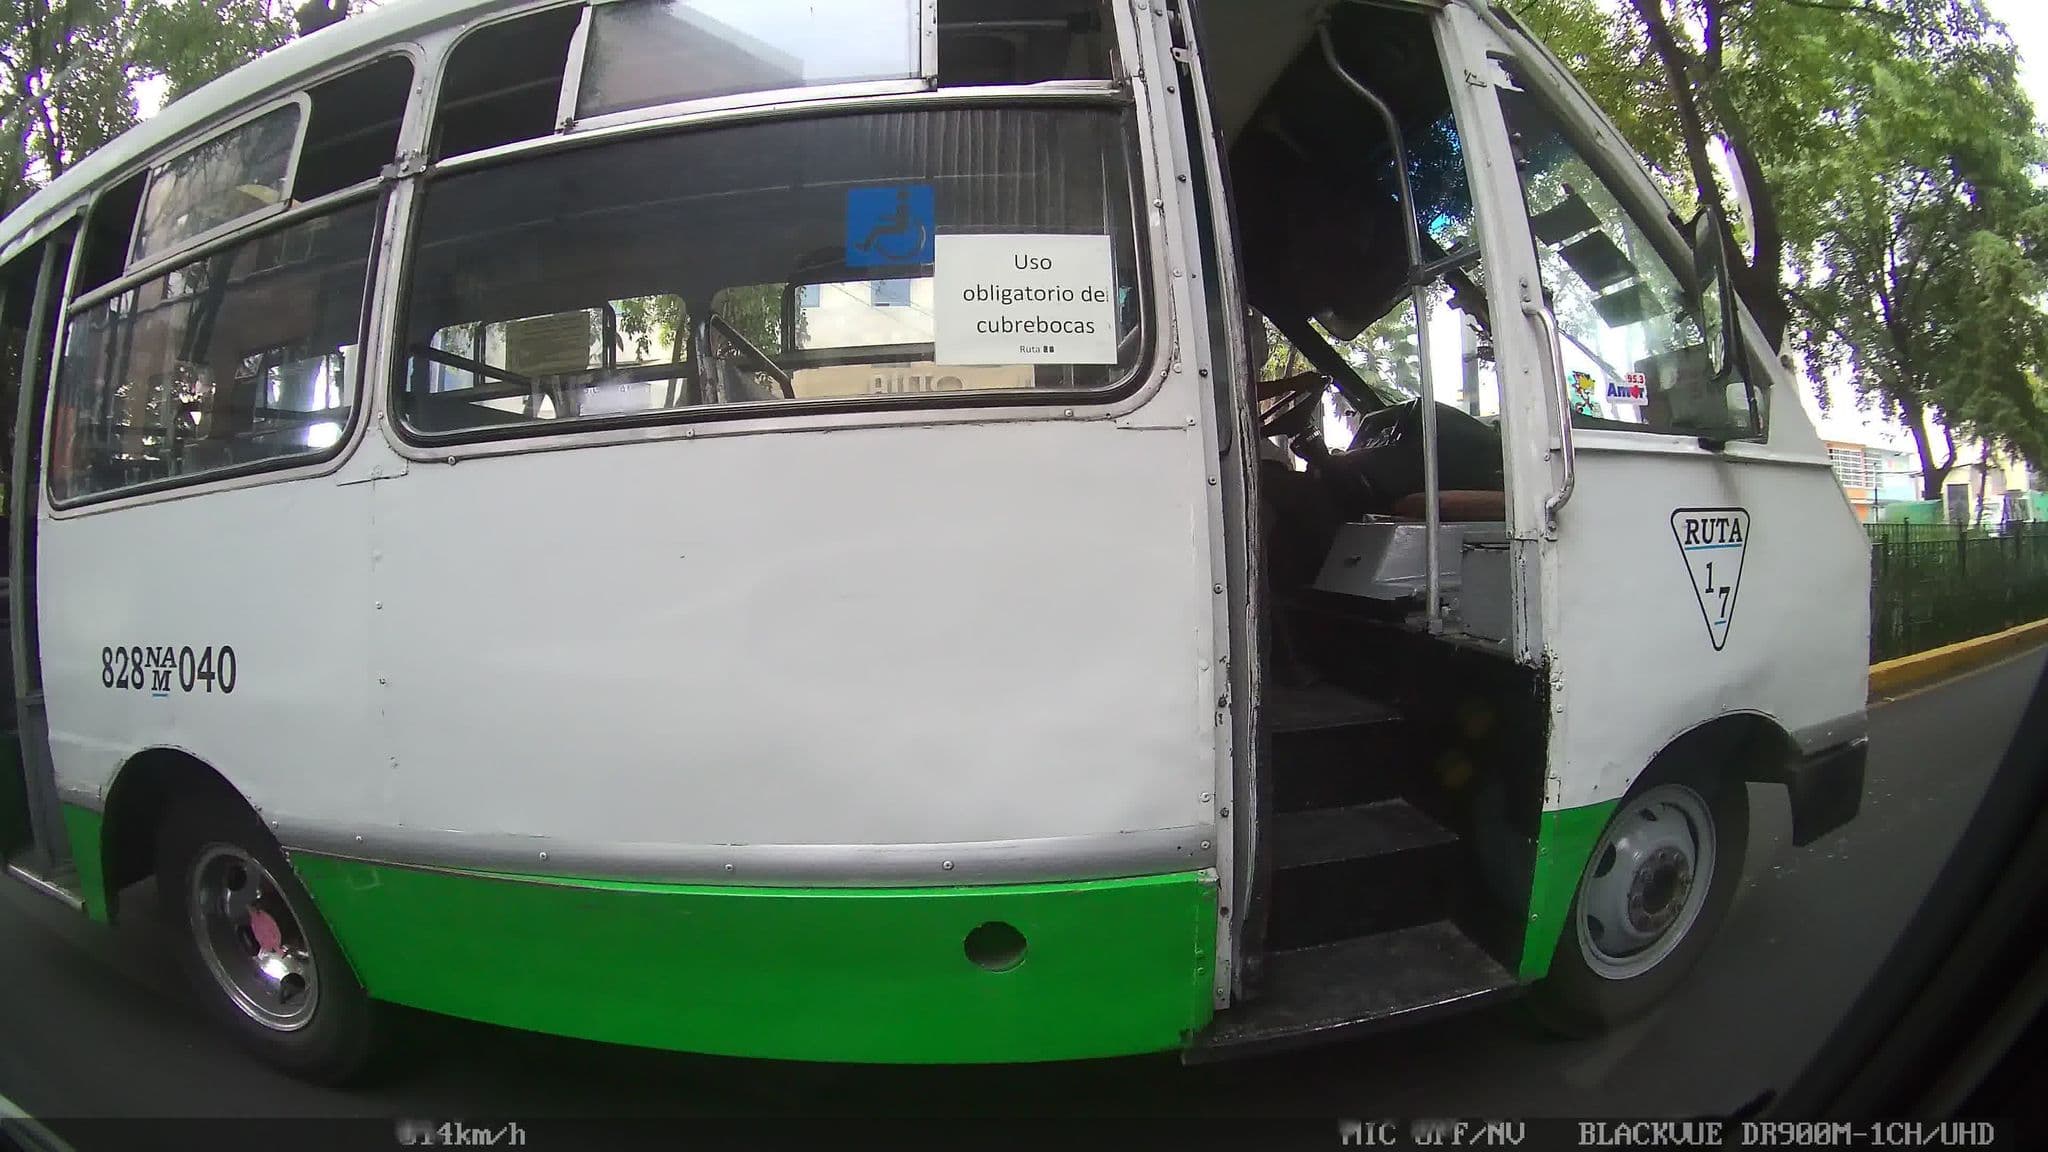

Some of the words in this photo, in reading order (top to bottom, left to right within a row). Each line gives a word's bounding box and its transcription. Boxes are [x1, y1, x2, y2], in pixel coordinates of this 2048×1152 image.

[1014, 253, 1053, 270] Uso
[962, 283, 1075, 305] obligatorio
[976, 315, 1096, 334] cubrebocas
[1019, 345, 1041, 354] Ruta
[1627, 374, 1646, 385] 95.3
[1684, 517, 1743, 545] RUTA
